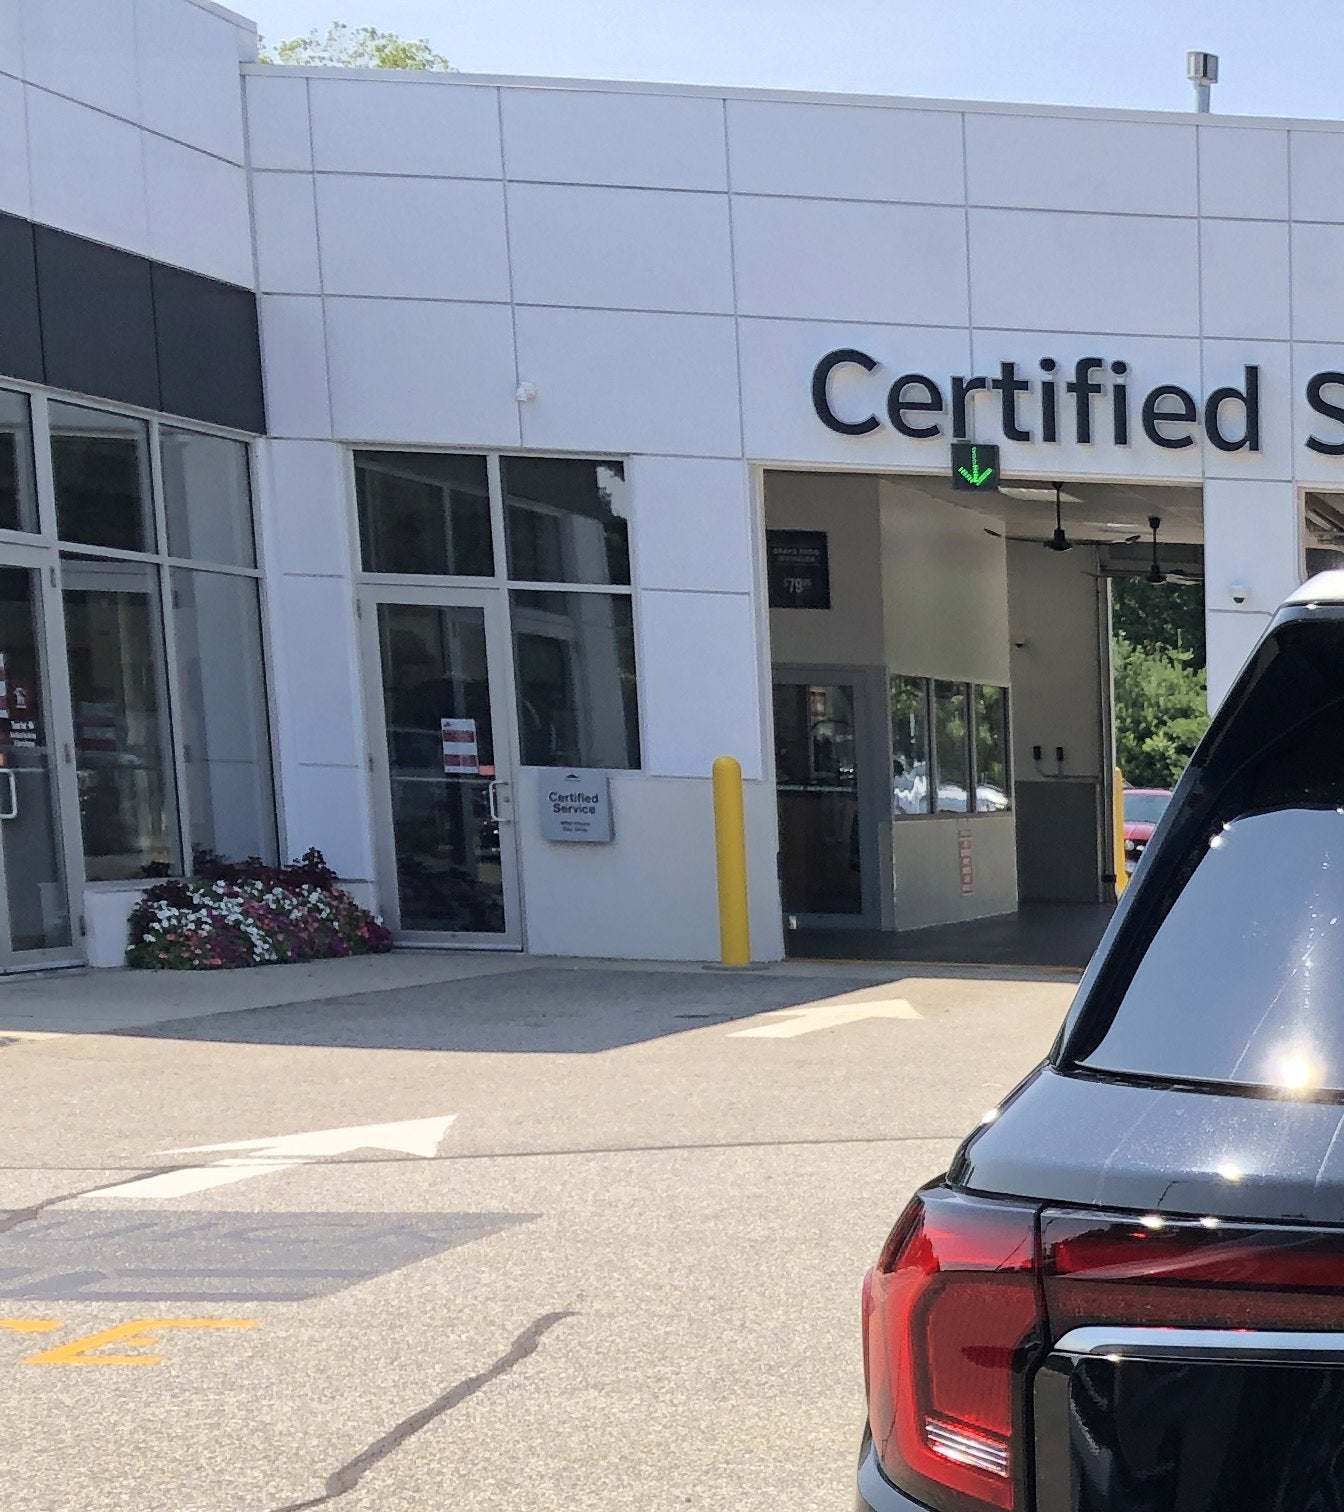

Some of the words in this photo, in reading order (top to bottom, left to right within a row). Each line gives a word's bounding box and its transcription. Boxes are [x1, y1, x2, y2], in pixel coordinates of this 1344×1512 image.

[811, 347, 1262, 452] Certified
[548, 791, 599, 803] Certified
[553, 803, 596, 815] Service
